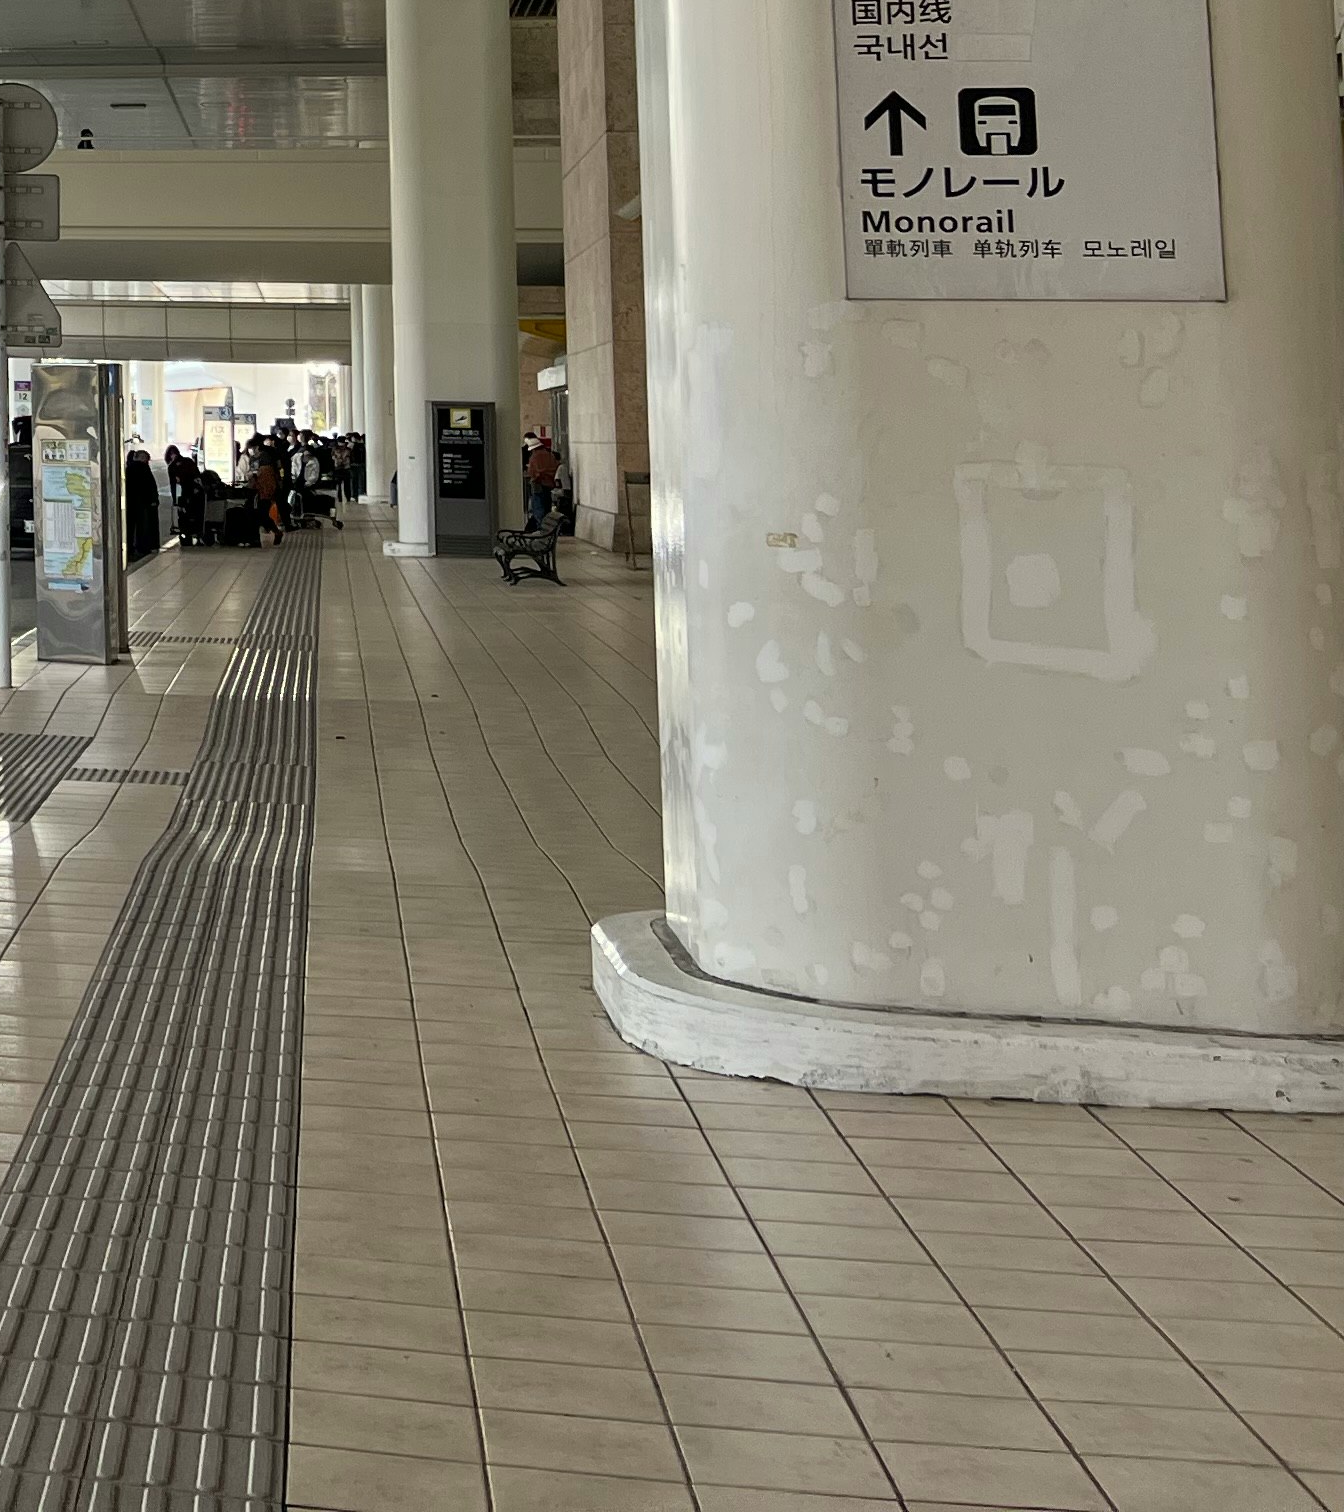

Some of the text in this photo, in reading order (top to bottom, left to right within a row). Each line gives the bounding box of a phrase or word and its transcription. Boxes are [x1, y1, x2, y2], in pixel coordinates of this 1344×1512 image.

[853, 33, 949, 61] 국내선
[860, 165, 1065, 199] モノレール
[861, 209, 1015, 234] Monorail
[864, 238, 1177, 260] 單軌列車 单轨列车 모노레일
